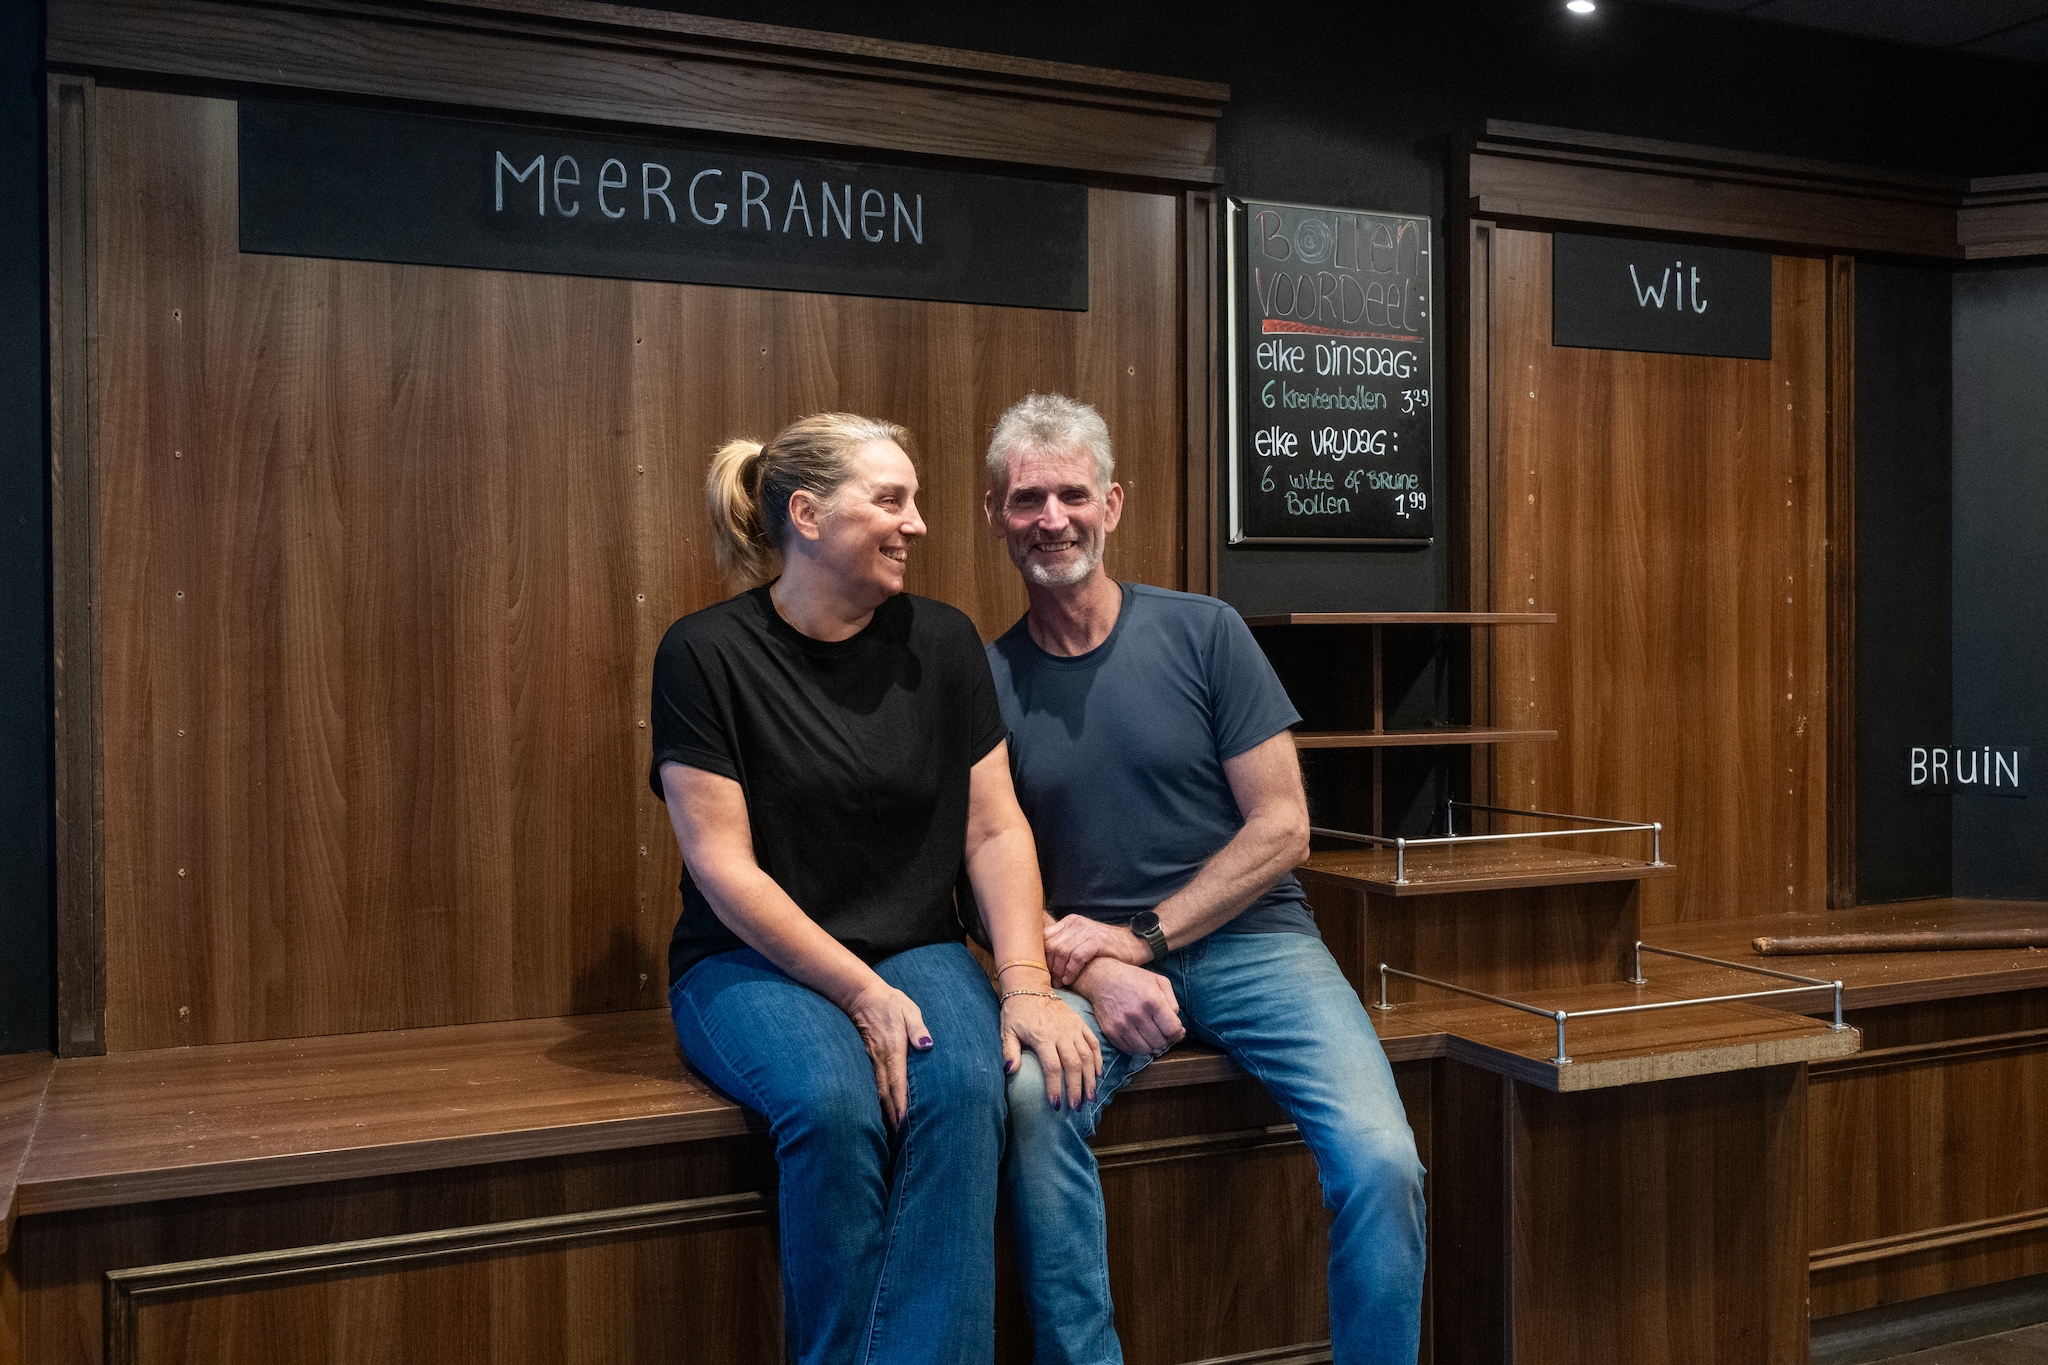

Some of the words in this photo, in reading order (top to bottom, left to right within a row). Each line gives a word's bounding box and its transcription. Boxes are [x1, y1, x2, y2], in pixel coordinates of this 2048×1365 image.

[1629, 260, 1708, 314] Wit
[1256, 339, 1305, 373] elke
[1261, 379, 1276, 409] 6
[1282, 380, 1387, 411] krentenbollen
[1255, 425, 1299, 458] elke
[1261, 464, 1275, 493] 6
[1289, 468, 1335, 491] witte
[1284, 490, 1350, 516] Bollen
